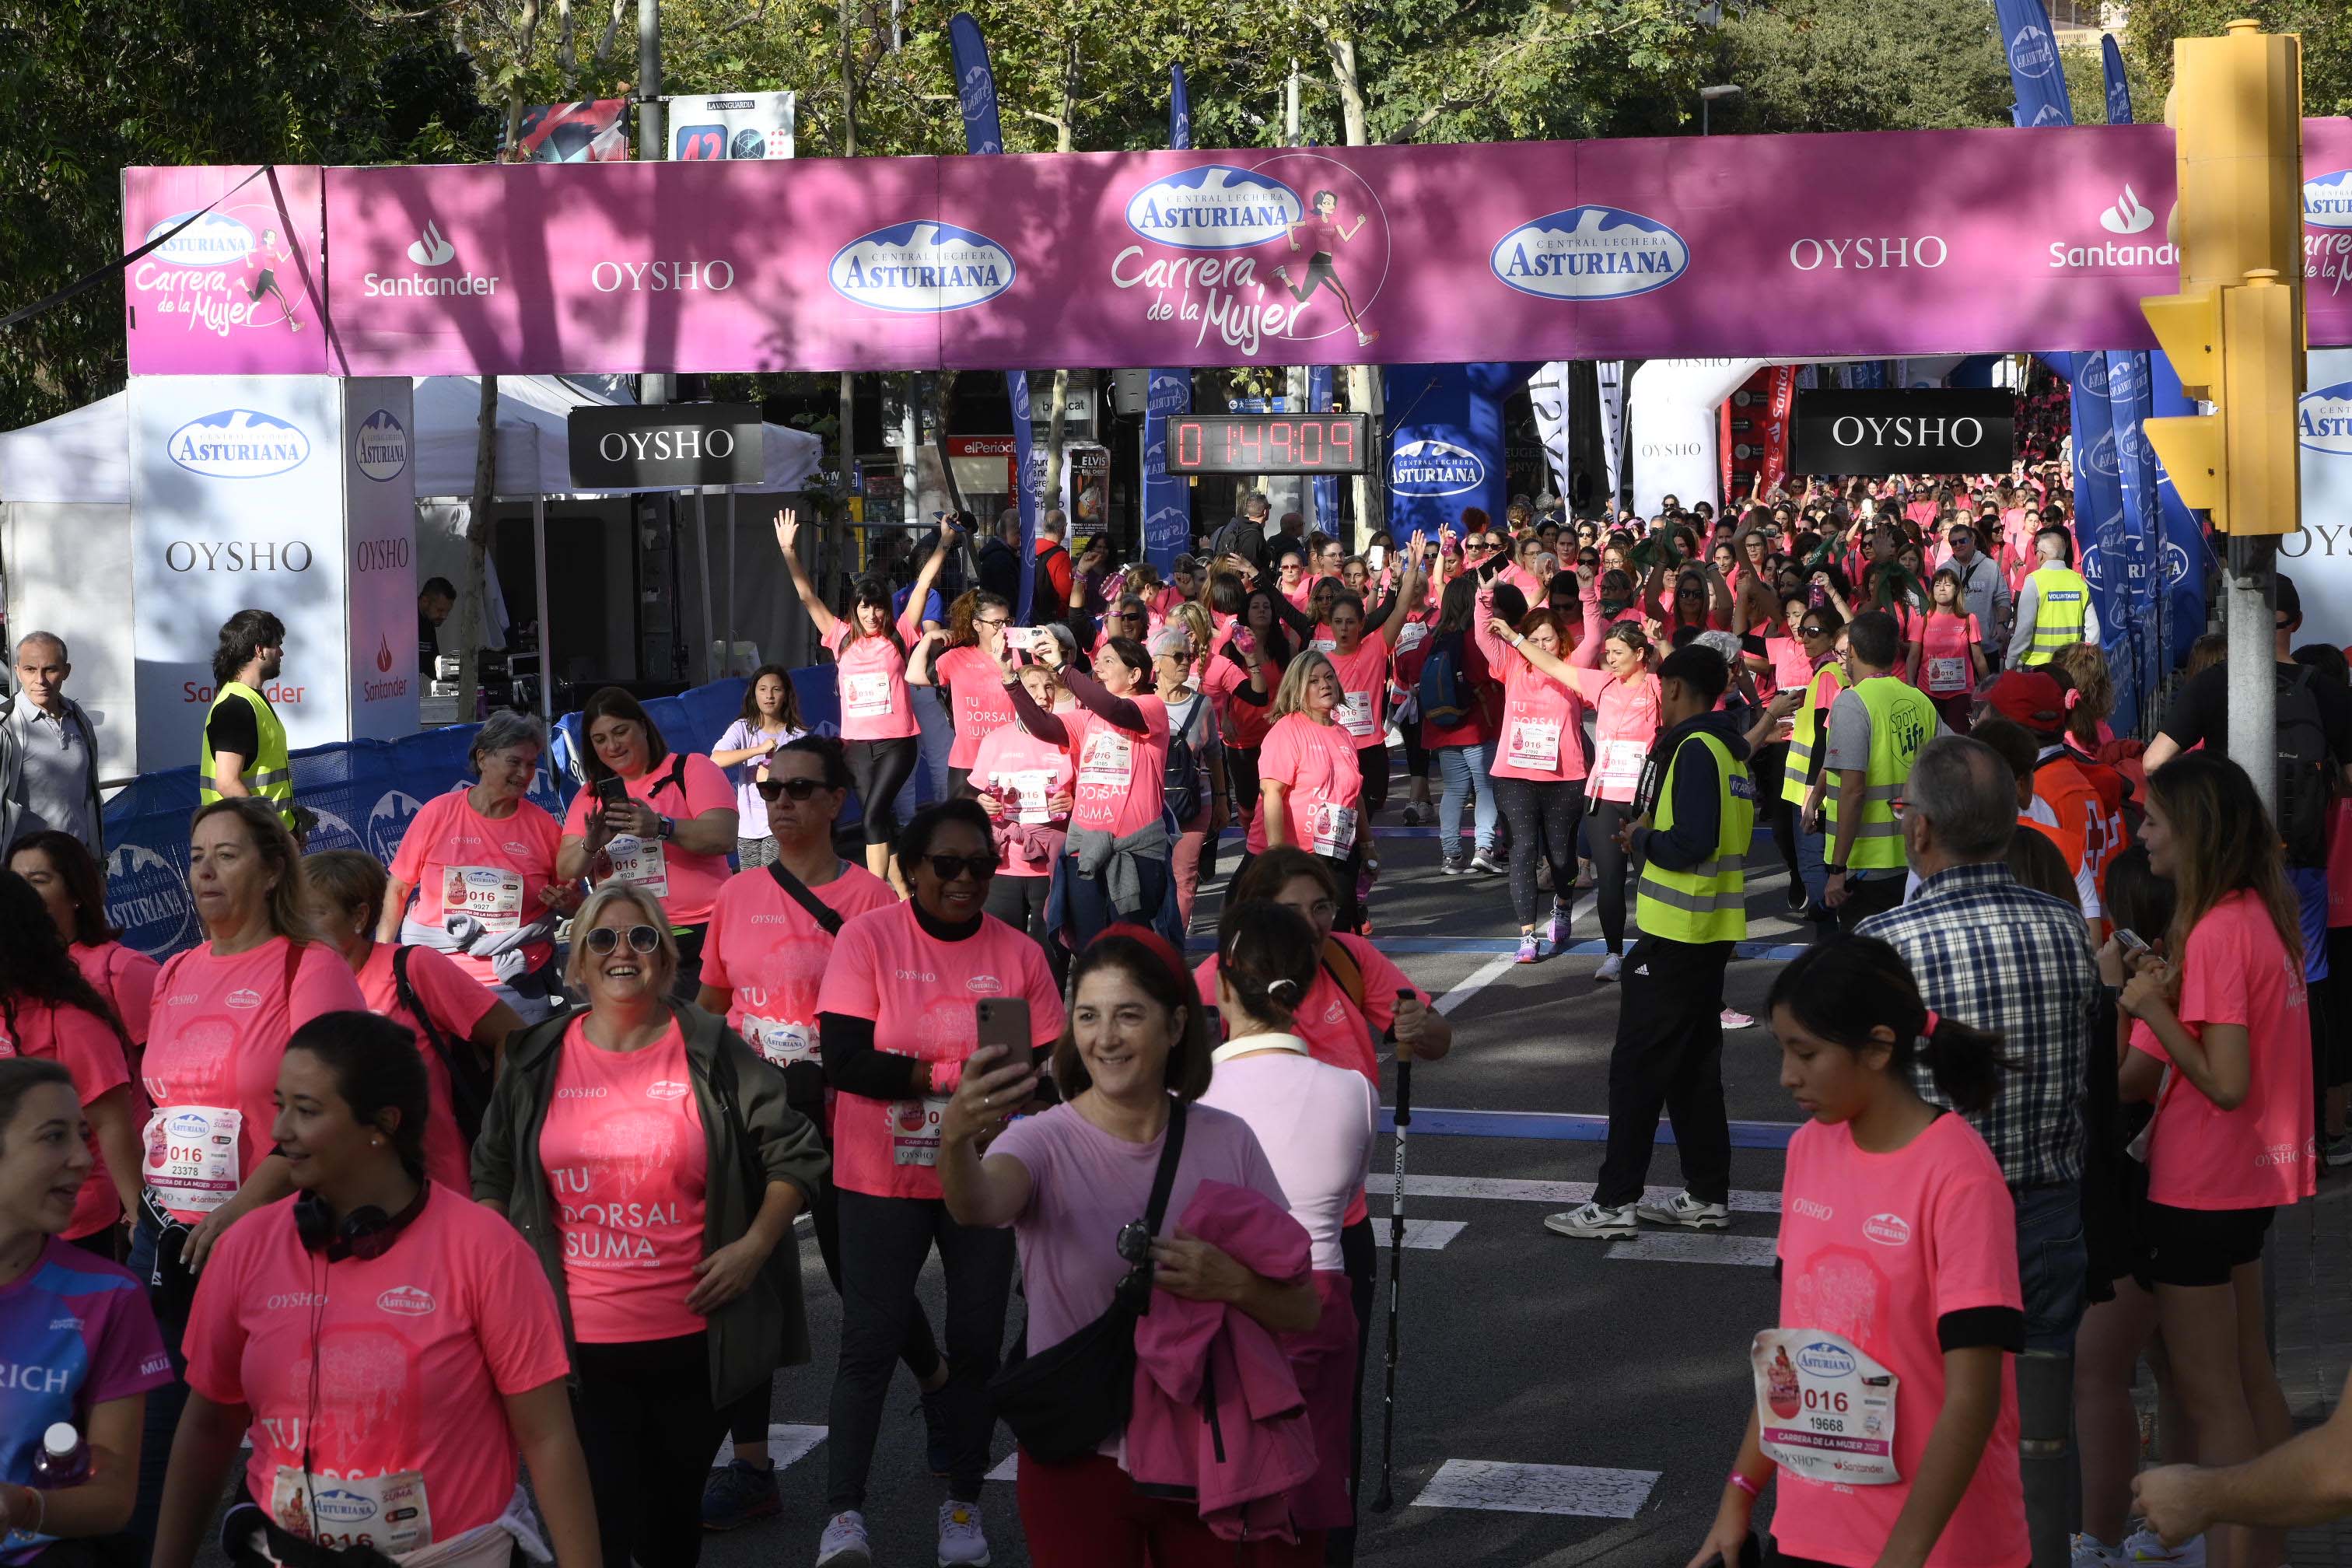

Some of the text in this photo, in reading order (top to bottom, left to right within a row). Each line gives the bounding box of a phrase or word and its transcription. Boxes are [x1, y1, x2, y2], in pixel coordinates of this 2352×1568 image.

[1227, 192, 1284, 202] LECHERA
[1140, 203, 1287, 229] ASTURIANA
[1537, 236, 1667, 248] CENTRAL LECHERA
[872, 251, 928, 261] CENTRAL
[1506, 242, 1674, 277] ASTURIANA
[1790, 236, 1948, 271] OYSHO
[591, 260, 734, 292] OYSHO
[844, 261, 1002, 289] ASTURIANA
[1111, 246, 1257, 289] Carrera
[2322, 257, 2336, 278] la
[135, 262, 226, 292] Carrera
[364, 272, 499, 298] Santander
[158, 289, 262, 337] de la Mujer
[1147, 282, 1310, 356] de la Mujer
[1832, 415, 1983, 448] OYSHO
[179, 435, 299, 462] ASTURIANA
[359, 439, 404, 464] ASTURIANA
[600, 429, 734, 462] OYSHO
[964, 441, 1017, 453] elPeriódi
[1642, 442, 1701, 458] OYSHO
[1082, 456, 1107, 466] ELVIS
[1390, 466, 1478, 485] ASTURIANA
[166, 540, 313, 572] OYSHO
[357, 537, 409, 573] OYSHO
[364, 677, 407, 703] Santander
[965, 696, 978, 707] TU
[1512, 701, 1526, 712] TU
[967, 711, 1013, 723] DORSAL
[1341, 709, 1357, 717] 016
[1892, 704, 1919, 734] Sport
[1524, 740, 1541, 749] 016
[1898, 722, 1924, 757] Life
[1094, 751, 1111, 760] 016
[1078, 803, 1114, 821] SUMA
[614, 859, 638, 871] 016
[469, 875, 499, 884] ASTURIANA
[469, 891, 495, 901] 016
[751, 914, 786, 924] OYSHO
[896, 969, 936, 982] OYSHO
[740, 986, 768, 1007] TU
[767, 1035, 803, 1047] ASTURIANA
[558, 1087, 608, 1099] OYSHO
[171, 1122, 207, 1133] ASTURIANA
[170, 1146, 203, 1163] 016
[172, 1165, 199, 1176] 23378
[150, 1177, 173, 1185] CARRERA
[551, 1167, 590, 1193] TU
[562, 1202, 681, 1228] DORSAL
[1792, 1197, 1833, 1221] OYSHO
[1867, 1221, 1906, 1239] ASTURIANA
[565, 1231, 656, 1258] SUMA
[642, 1259, 660, 1268] 2023
[267, 1292, 330, 1309] OYSHO
[380, 1295, 432, 1309] ASTURIANA
[1801, 1353, 1851, 1370] ASTURIANA
[1804, 1388, 1849, 1412] 016
[1811, 1416, 1844, 1432] 19668
[261, 1418, 299, 1451] TU
[1778, 1432, 1811, 1444] CARRERA
[1813, 1437, 1824, 1446] DE
[1836, 1440, 1862, 1451] MUJER
[1864, 1443, 1880, 1451] 2023
[1843, 1461, 1885, 1474] Santander
[312, 1499, 373, 1515] ASTURIANA
